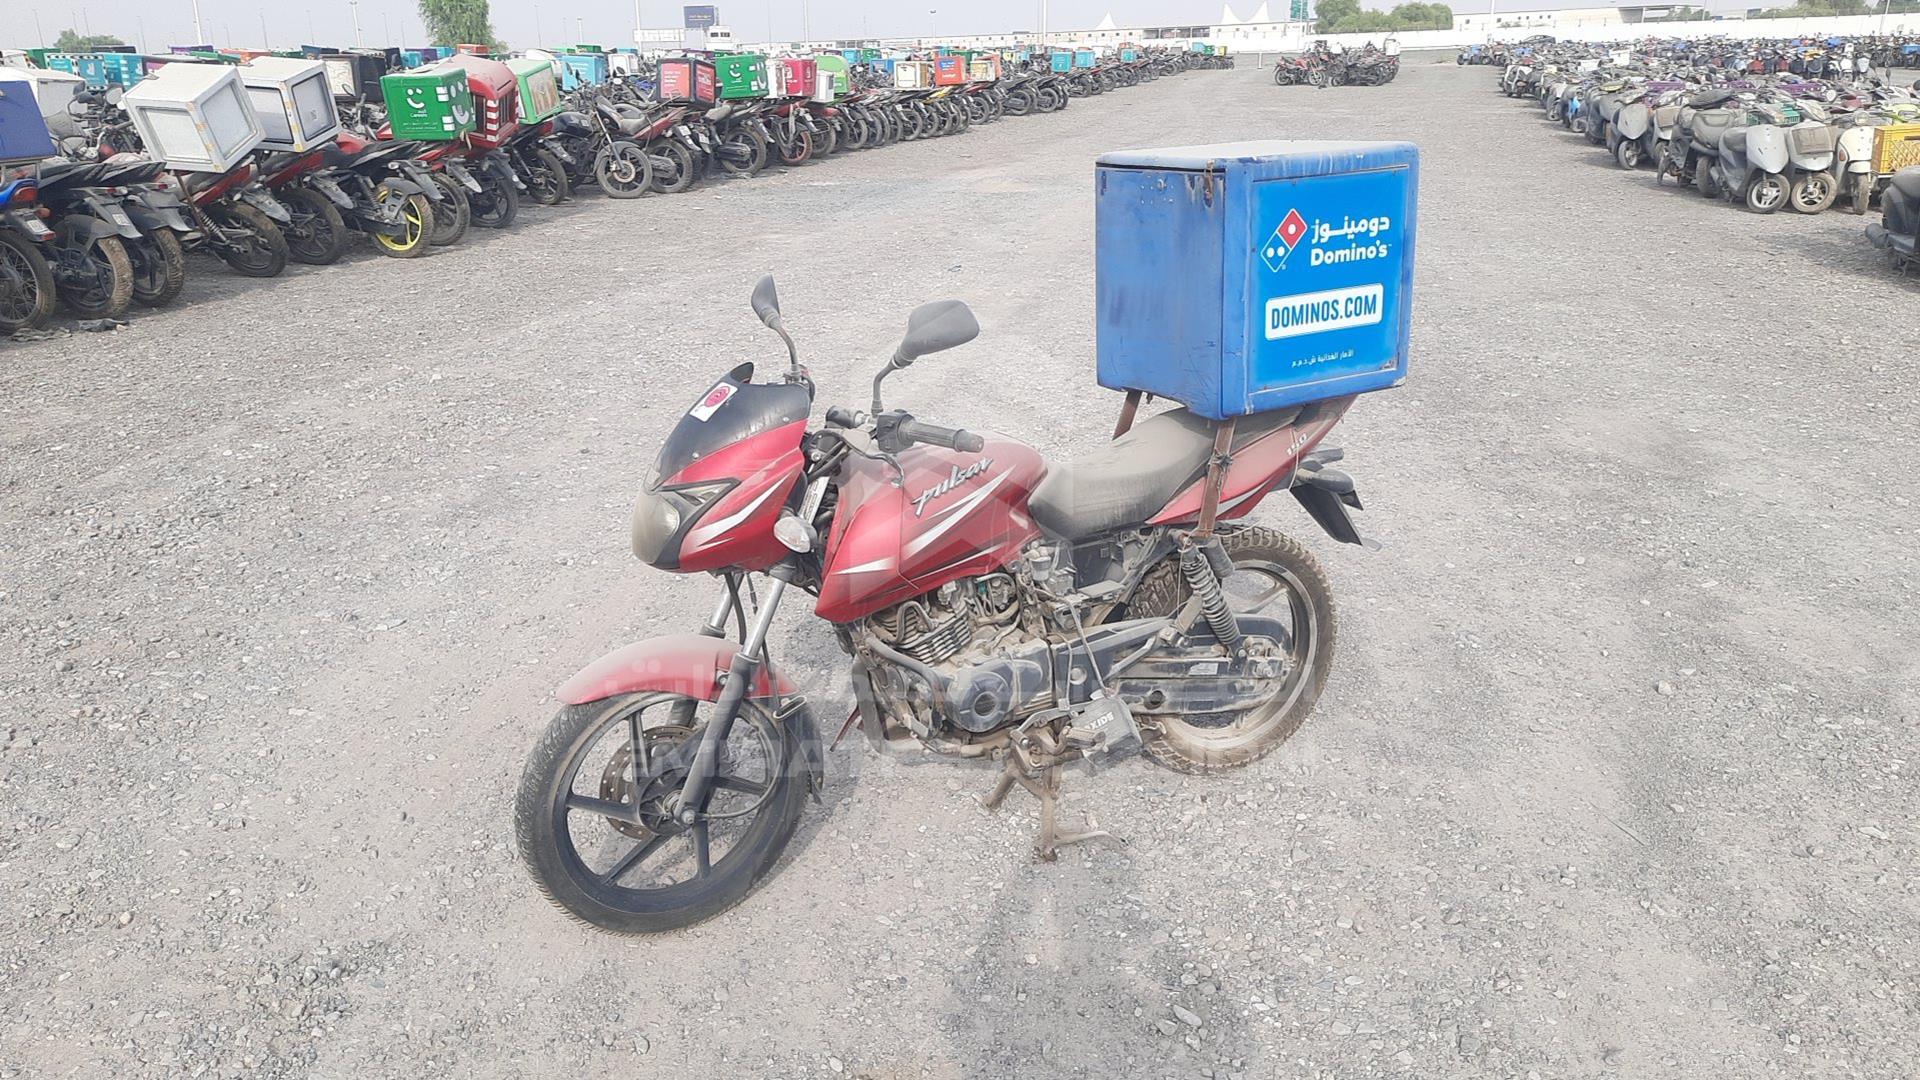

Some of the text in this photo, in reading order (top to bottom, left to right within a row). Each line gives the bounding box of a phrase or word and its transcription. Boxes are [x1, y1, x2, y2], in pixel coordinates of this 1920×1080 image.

[1311, 215, 1390, 244] دومينوز
[1310, 239, 1388, 267] Domino's
[1271, 294, 1377, 330] DOMINOS.COM
[911, 456, 993, 517] pulsar
